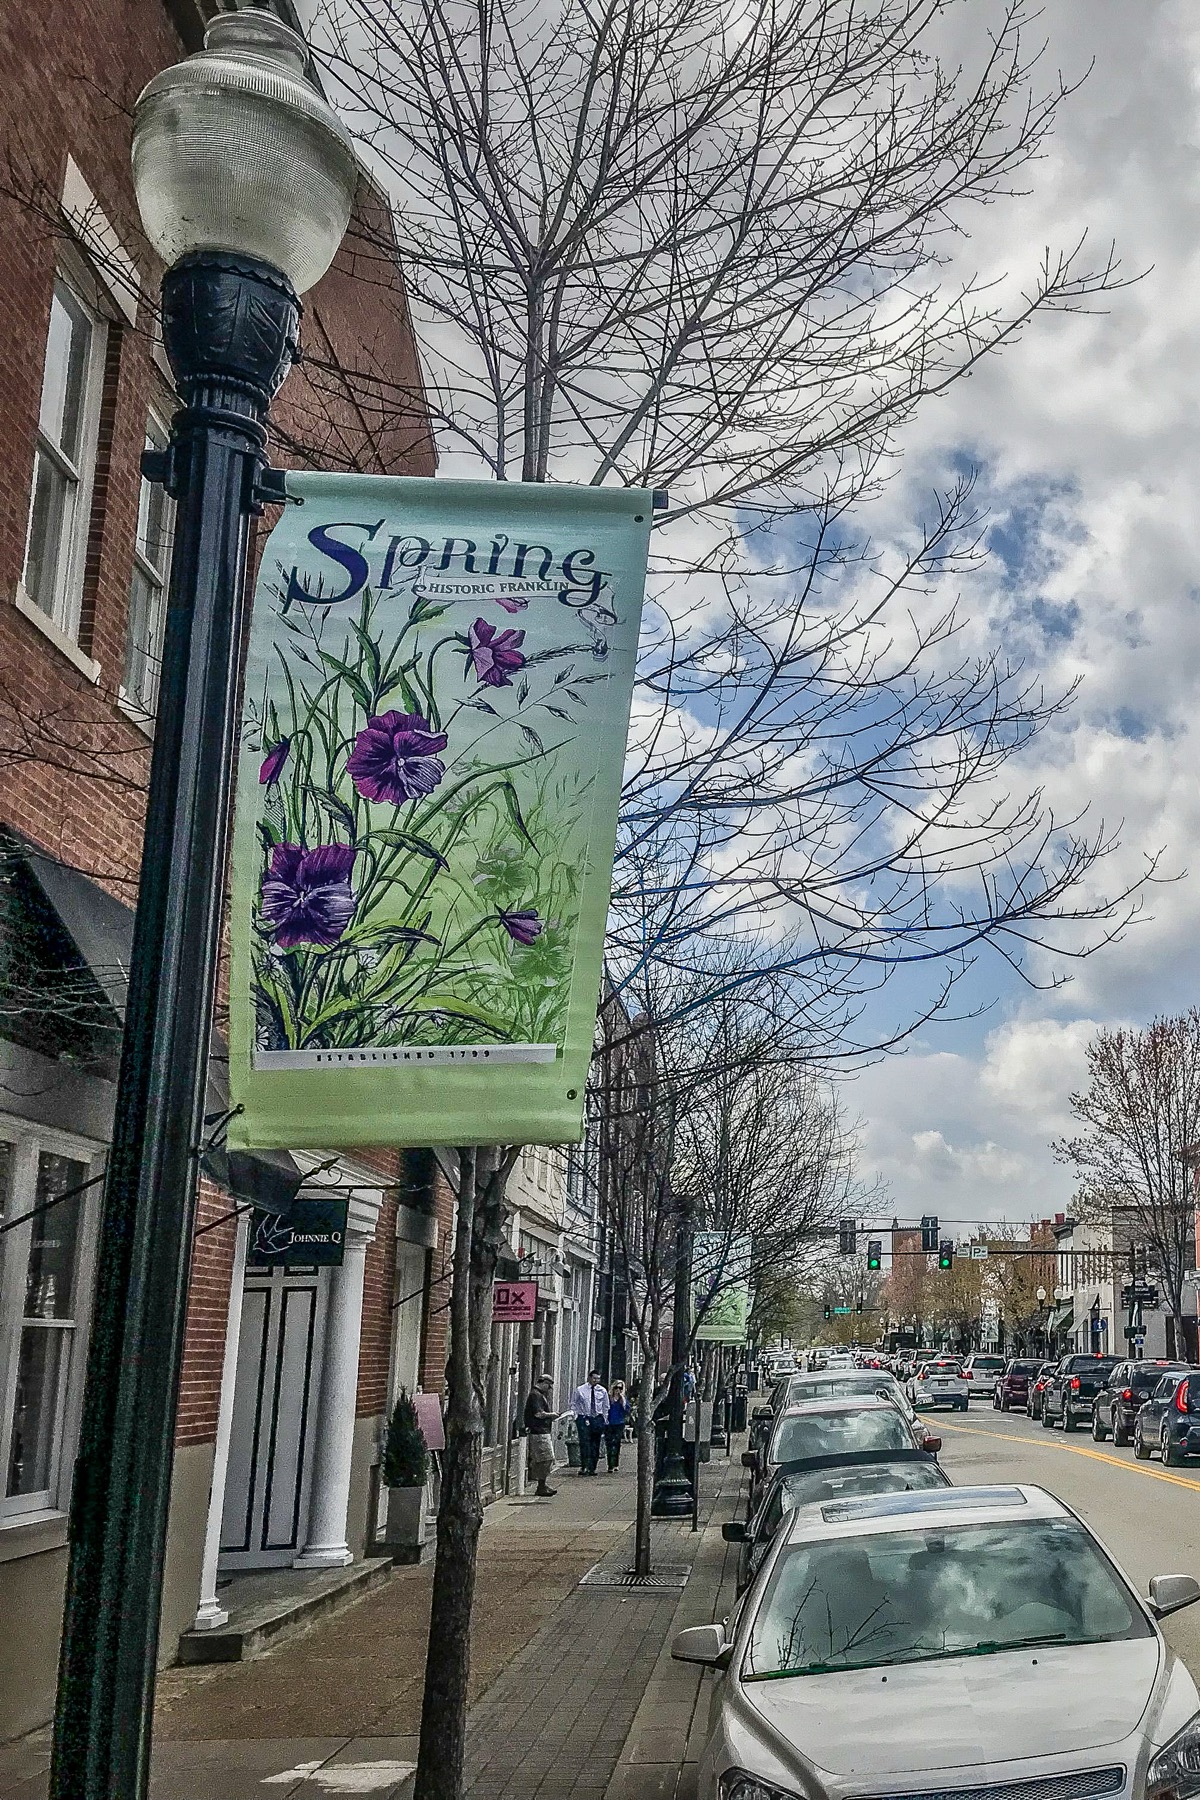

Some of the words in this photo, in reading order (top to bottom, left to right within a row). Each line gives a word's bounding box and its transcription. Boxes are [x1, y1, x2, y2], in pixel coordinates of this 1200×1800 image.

[428, 582, 494, 593] HISTORIC
[499, 580, 569, 593] FRANKLIN
[316, 1051, 435, 1062] ESTABLISHED
[450, 1050, 490, 1058] 1799
[331, 1231, 342, 1244] Q
